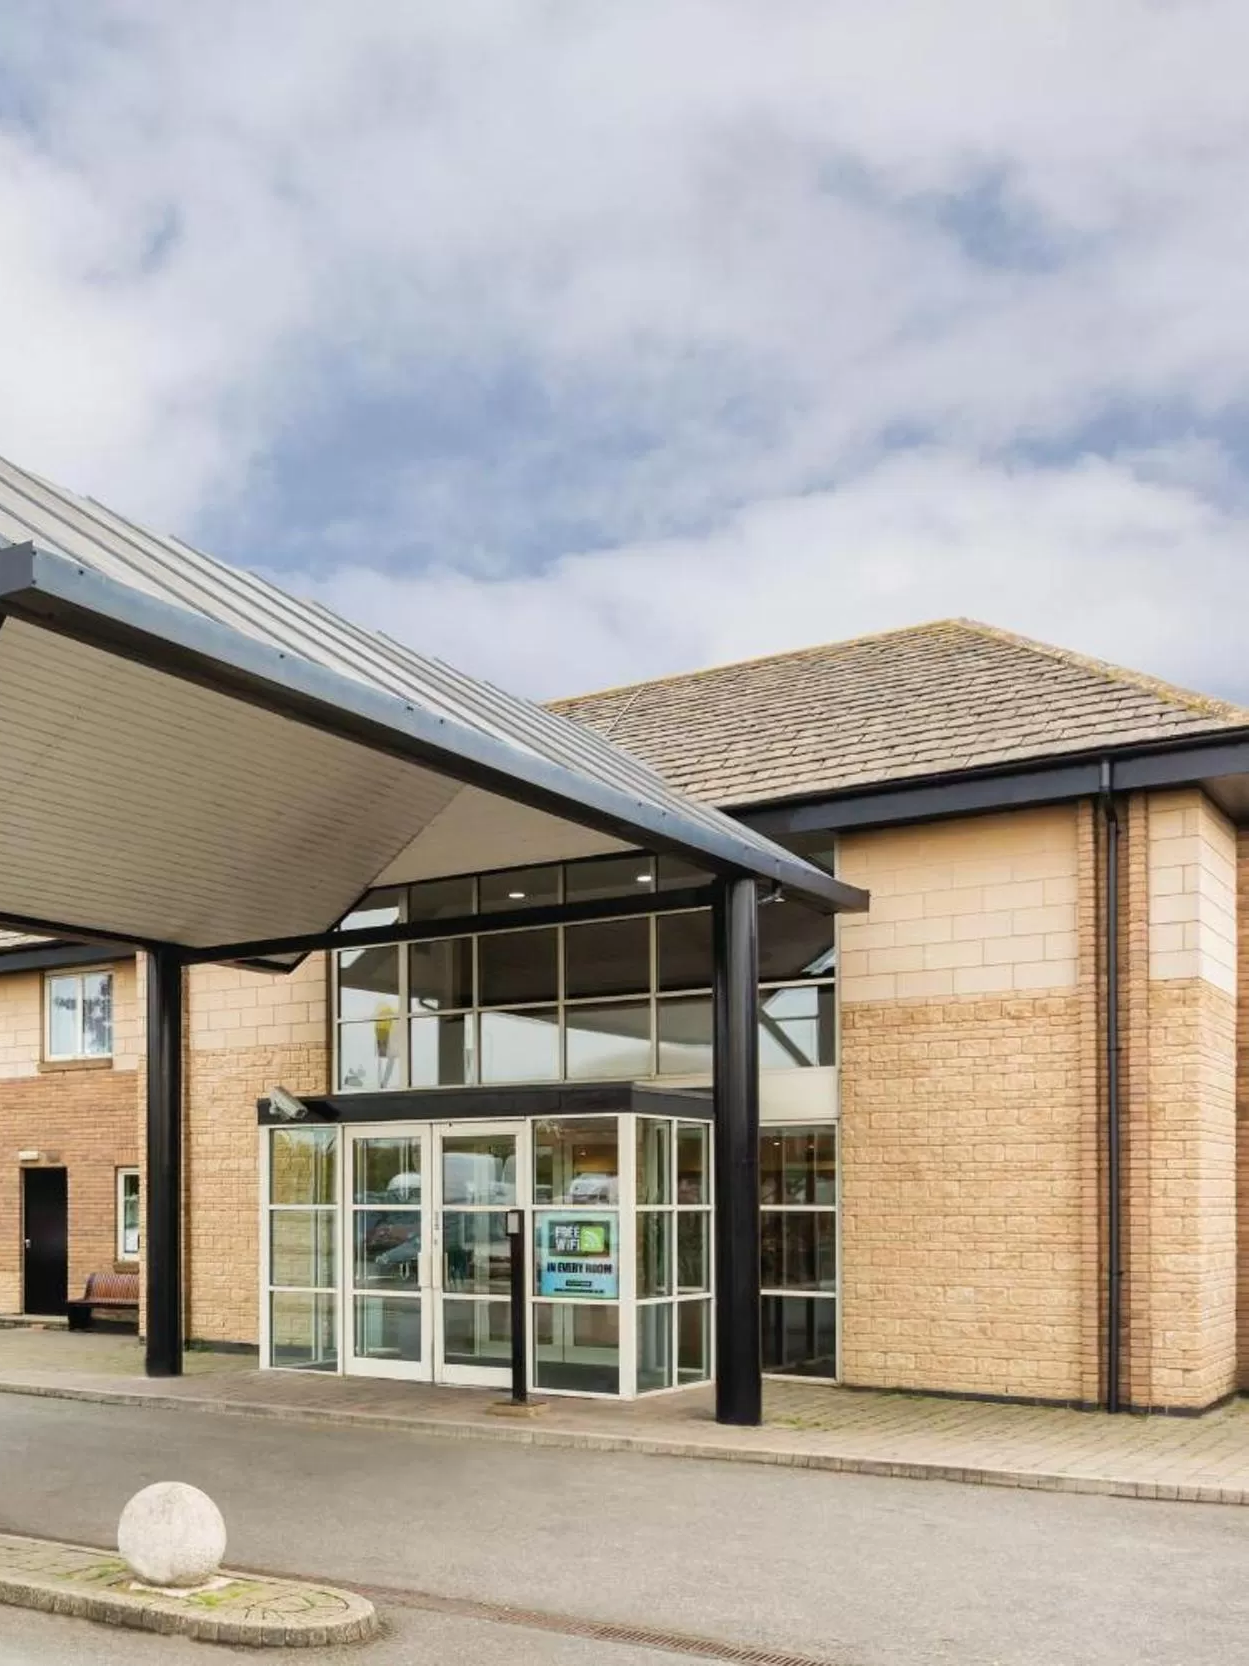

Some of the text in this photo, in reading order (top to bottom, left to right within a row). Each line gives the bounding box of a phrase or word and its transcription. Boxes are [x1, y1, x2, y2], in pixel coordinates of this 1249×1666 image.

[555, 1226, 580, 1239] FREE
[547, 1262, 556, 1273] IN
[557, 1262, 583, 1273] EVERY
